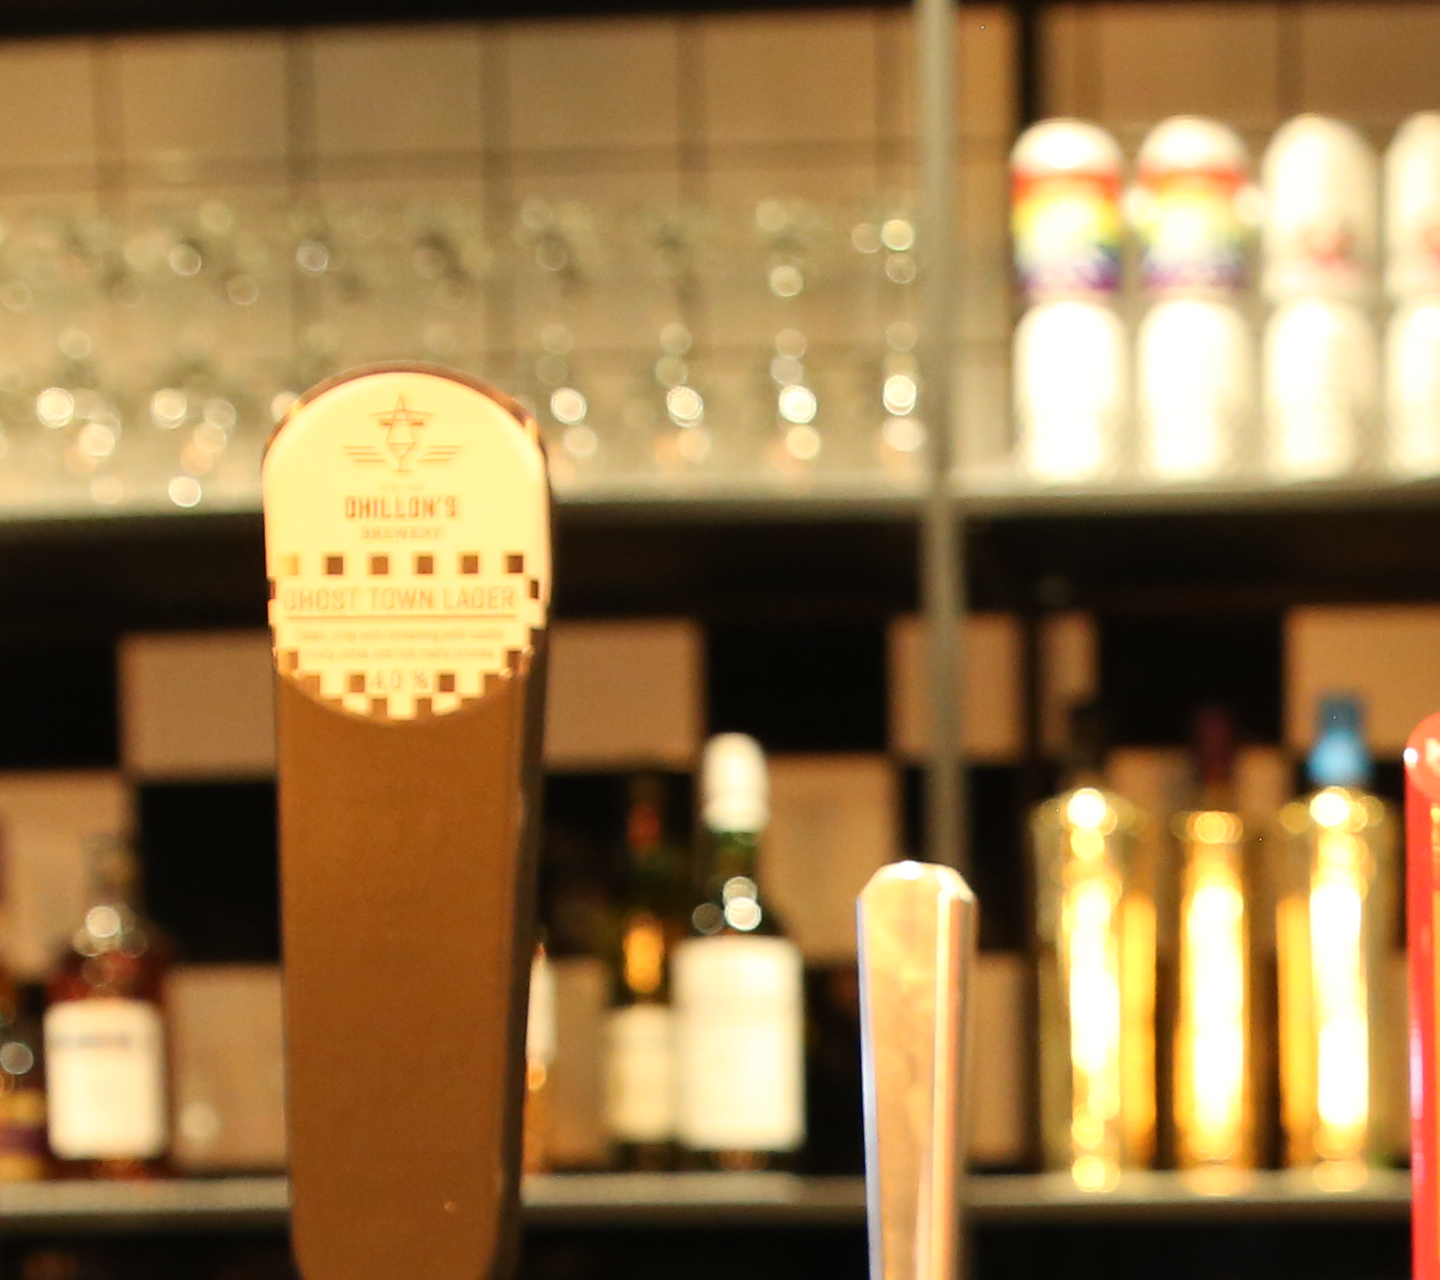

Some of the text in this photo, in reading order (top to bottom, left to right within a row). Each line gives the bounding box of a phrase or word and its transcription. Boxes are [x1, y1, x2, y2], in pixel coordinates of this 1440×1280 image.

[344, 495, 458, 519] DHILLON'S
[282, 586, 516, 611] GHOST TOWN LAGER
